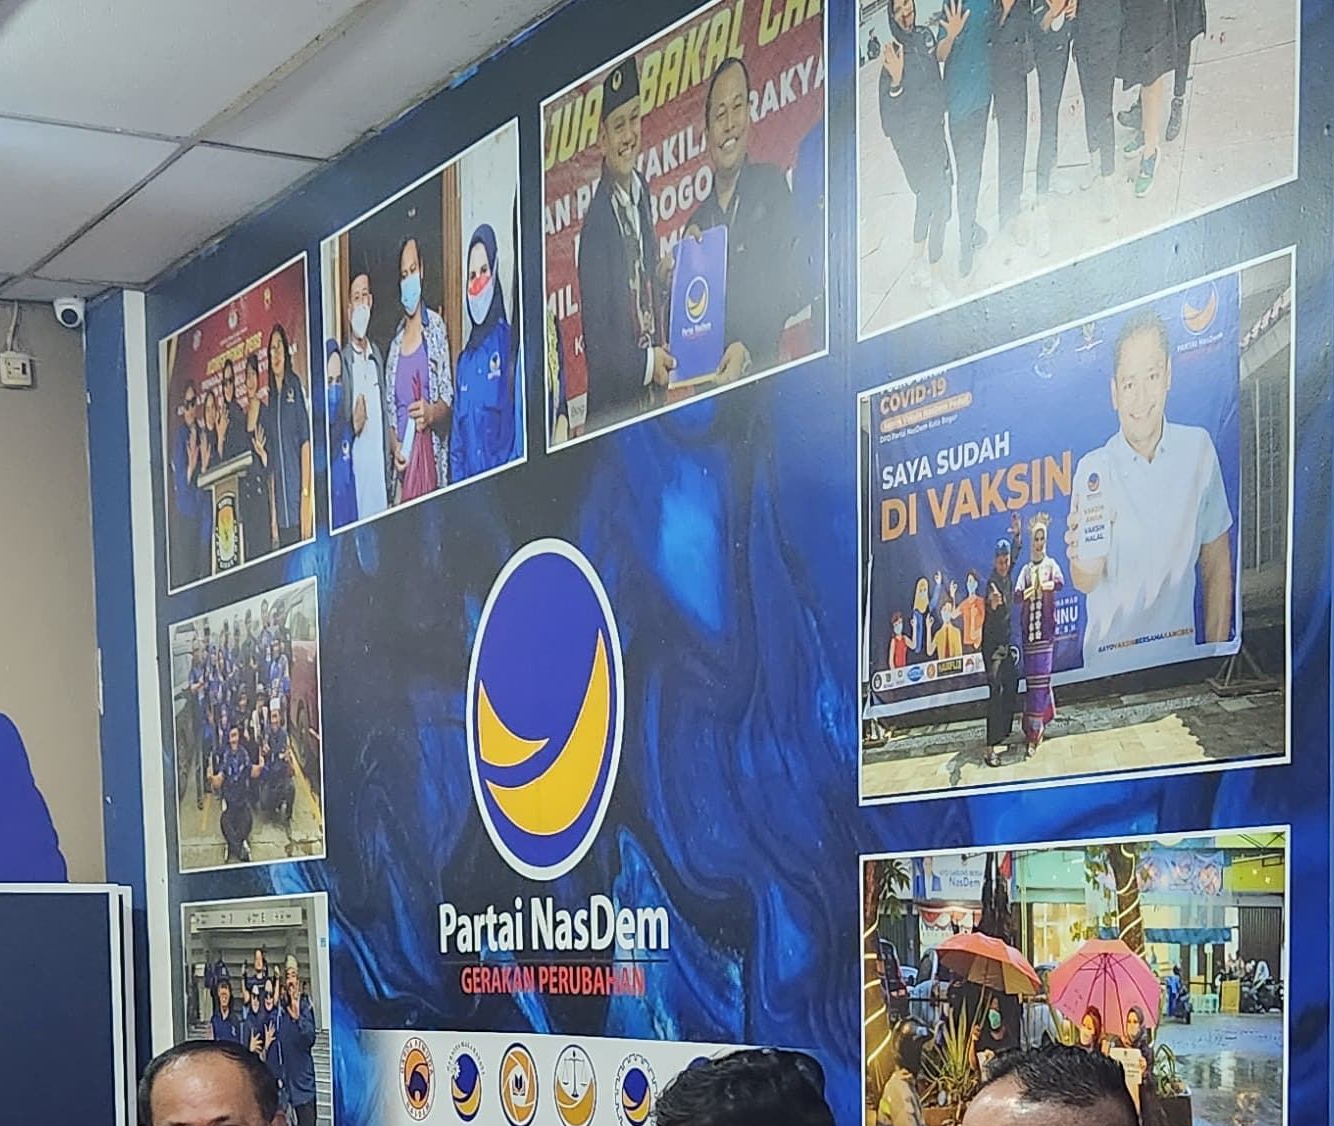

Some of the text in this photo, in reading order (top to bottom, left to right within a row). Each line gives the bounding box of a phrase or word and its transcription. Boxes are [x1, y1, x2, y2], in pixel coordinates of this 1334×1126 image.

[640, 0, 745, 116] BAKAL
[881, 377, 946, 415] COVID-19
[882, 431, 1010, 490] SAYA SUDAH
[881, 451, 1072, 542] DI VAKSIN
[439, 895, 669, 953] Partai NasDem
[461, 966, 645, 996] GERAKAN PERUBAHAN
